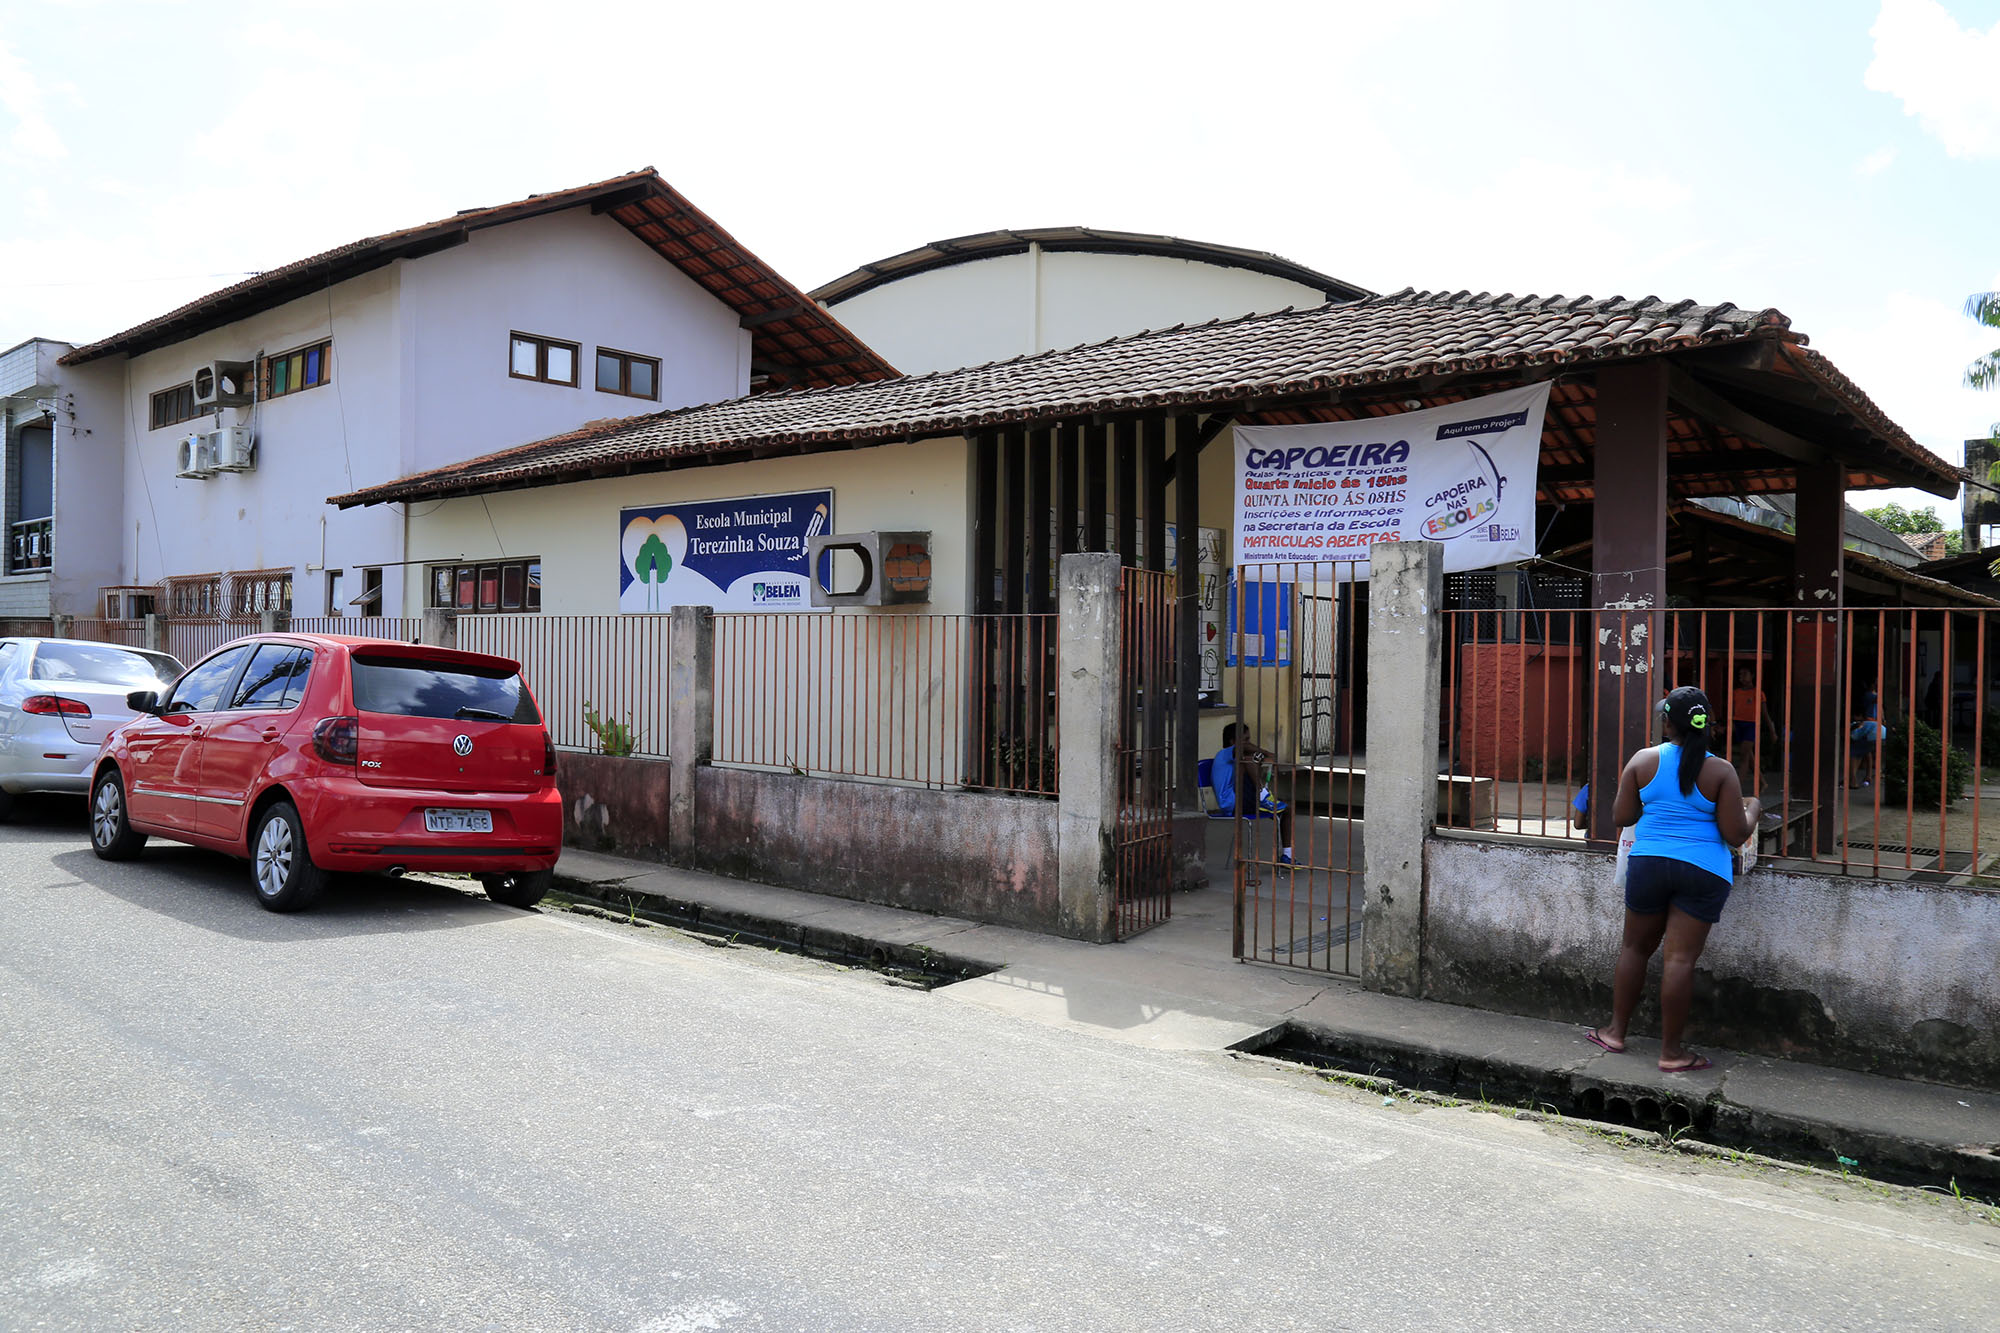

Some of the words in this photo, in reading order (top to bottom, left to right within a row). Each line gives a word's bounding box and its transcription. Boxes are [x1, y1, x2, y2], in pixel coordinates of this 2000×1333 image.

[1443, 426, 1463, 435] Aqui
[1464, 424, 1480, 432] tem
[1245, 439, 1410, 471] CAPOEIRA
[1245, 470, 1274, 478] Aulas
[1277, 469, 1331, 479] Práticas
[1346, 465, 1408, 476] Teóricas
[1245, 478, 1289, 490] Quarta
[1367, 474, 1408, 488] 15hs
[1244, 493, 1289, 507] QUINTA
[1343, 489, 1365, 506] ÁS
[1368, 489, 1407, 505] 08HS
[1425, 476, 1487, 508] CAPOEIRA
[1446, 495, 1468, 511] NAS
[696, 513, 731, 529] Escola
[733, 507, 792, 528] Municipal
[1244, 508, 1301, 519] Inscrições
[1304, 510, 1312, 518] e
[1314, 506, 1405, 518] Informações
[1427, 497, 1495, 535] ESCOLAS
[1243, 523, 1256, 532] na
[1257, 520, 1324, 532] Secretaria
[1327, 520, 1345, 531] da
[1348, 517, 1401, 530] Escola
[1243, 535, 1324, 548] MATRICULAS
[1326, 530, 1401, 548] ABERTAS
[1501, 528, 1520, 541] BELEM
[690, 534, 754, 555] Terezinha
[758, 533, 800, 552] Souza
[1244, 552, 1273, 560] Ministrante
[1274, 552, 1287, 560] Arte
[1322, 553, 1366, 561] Mestre
[766, 584, 801, 598] BELEM
[361, 760, 382, 768] FOX
